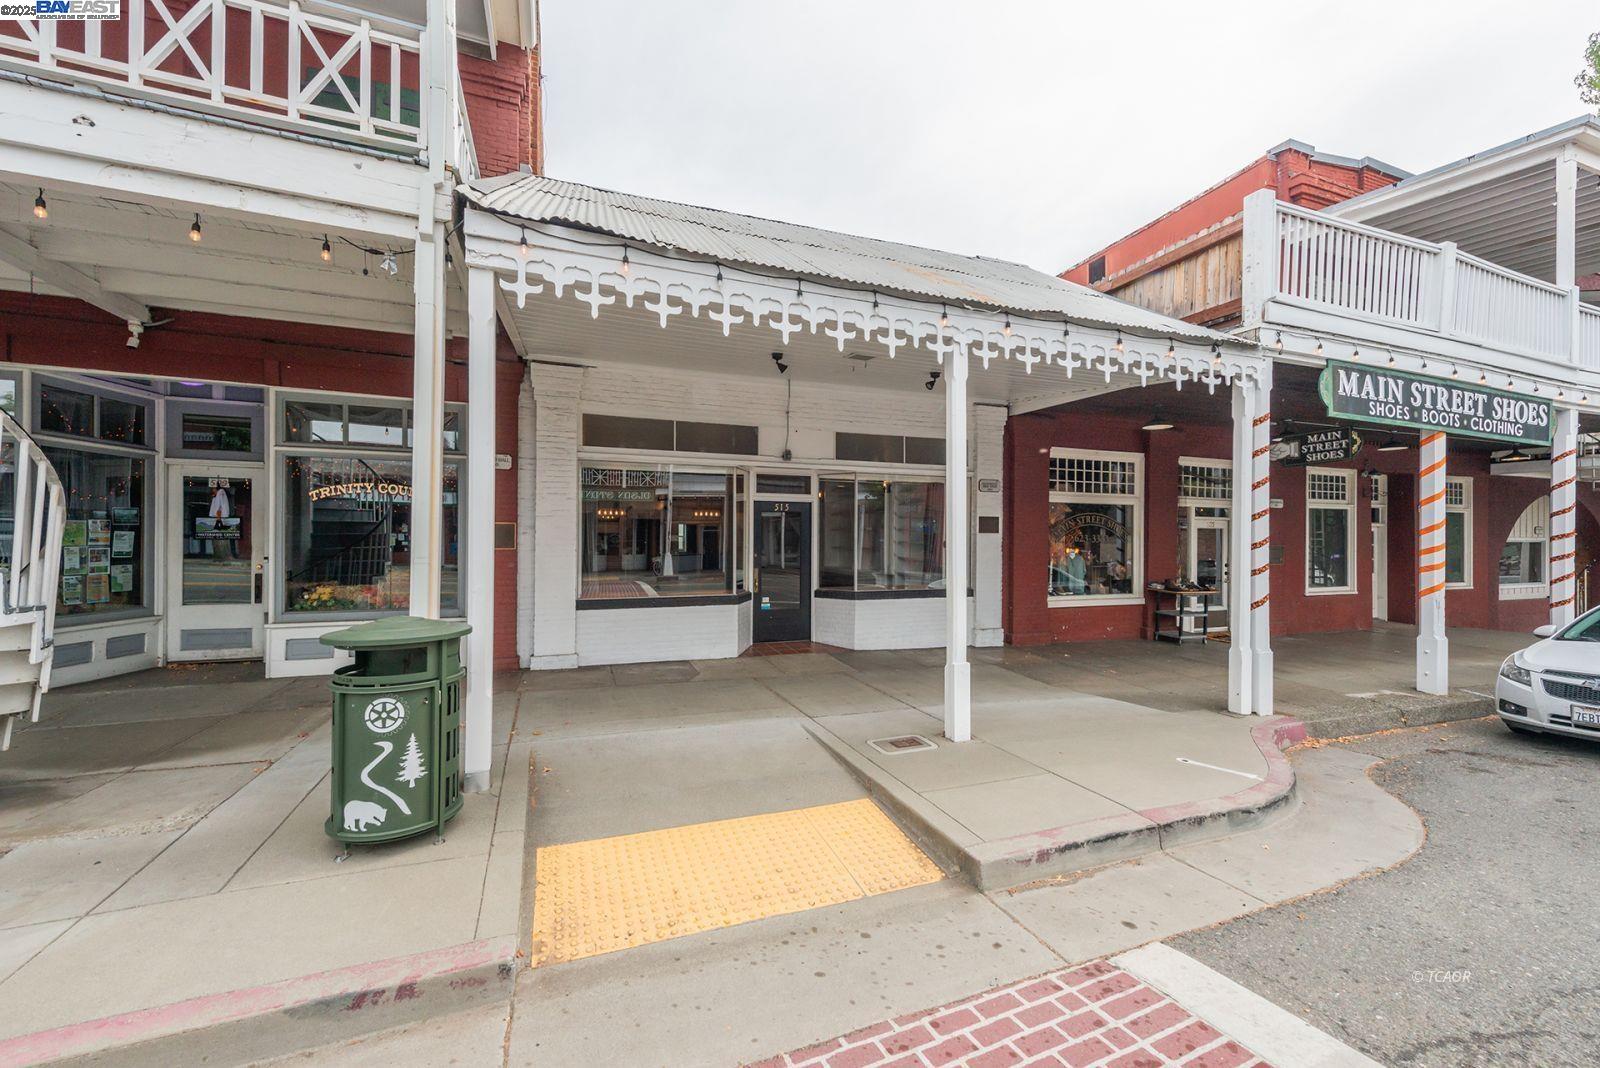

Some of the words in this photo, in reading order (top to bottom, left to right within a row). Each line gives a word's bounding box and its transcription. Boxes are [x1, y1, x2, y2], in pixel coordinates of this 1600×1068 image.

[1338, 369, 1405, 404] MAIN
[1411, 381, 1487, 418] STREET
[1492, 396, 1548, 426] SHOES
[1369, 401, 1410, 420] SHOES
[1422, 409, 1460, 428] BOOTS
[1470, 417, 1524, 437] CLOTHING
[1307, 431, 1343, 443] MAIN
[1301, 439, 1349, 453] STREET
[1306, 449, 1345, 462] SHOES
[309, 482, 375, 501] TRINITY
[774, 503, 790, 511] 515
[1077, 515, 1105, 525] STREET
